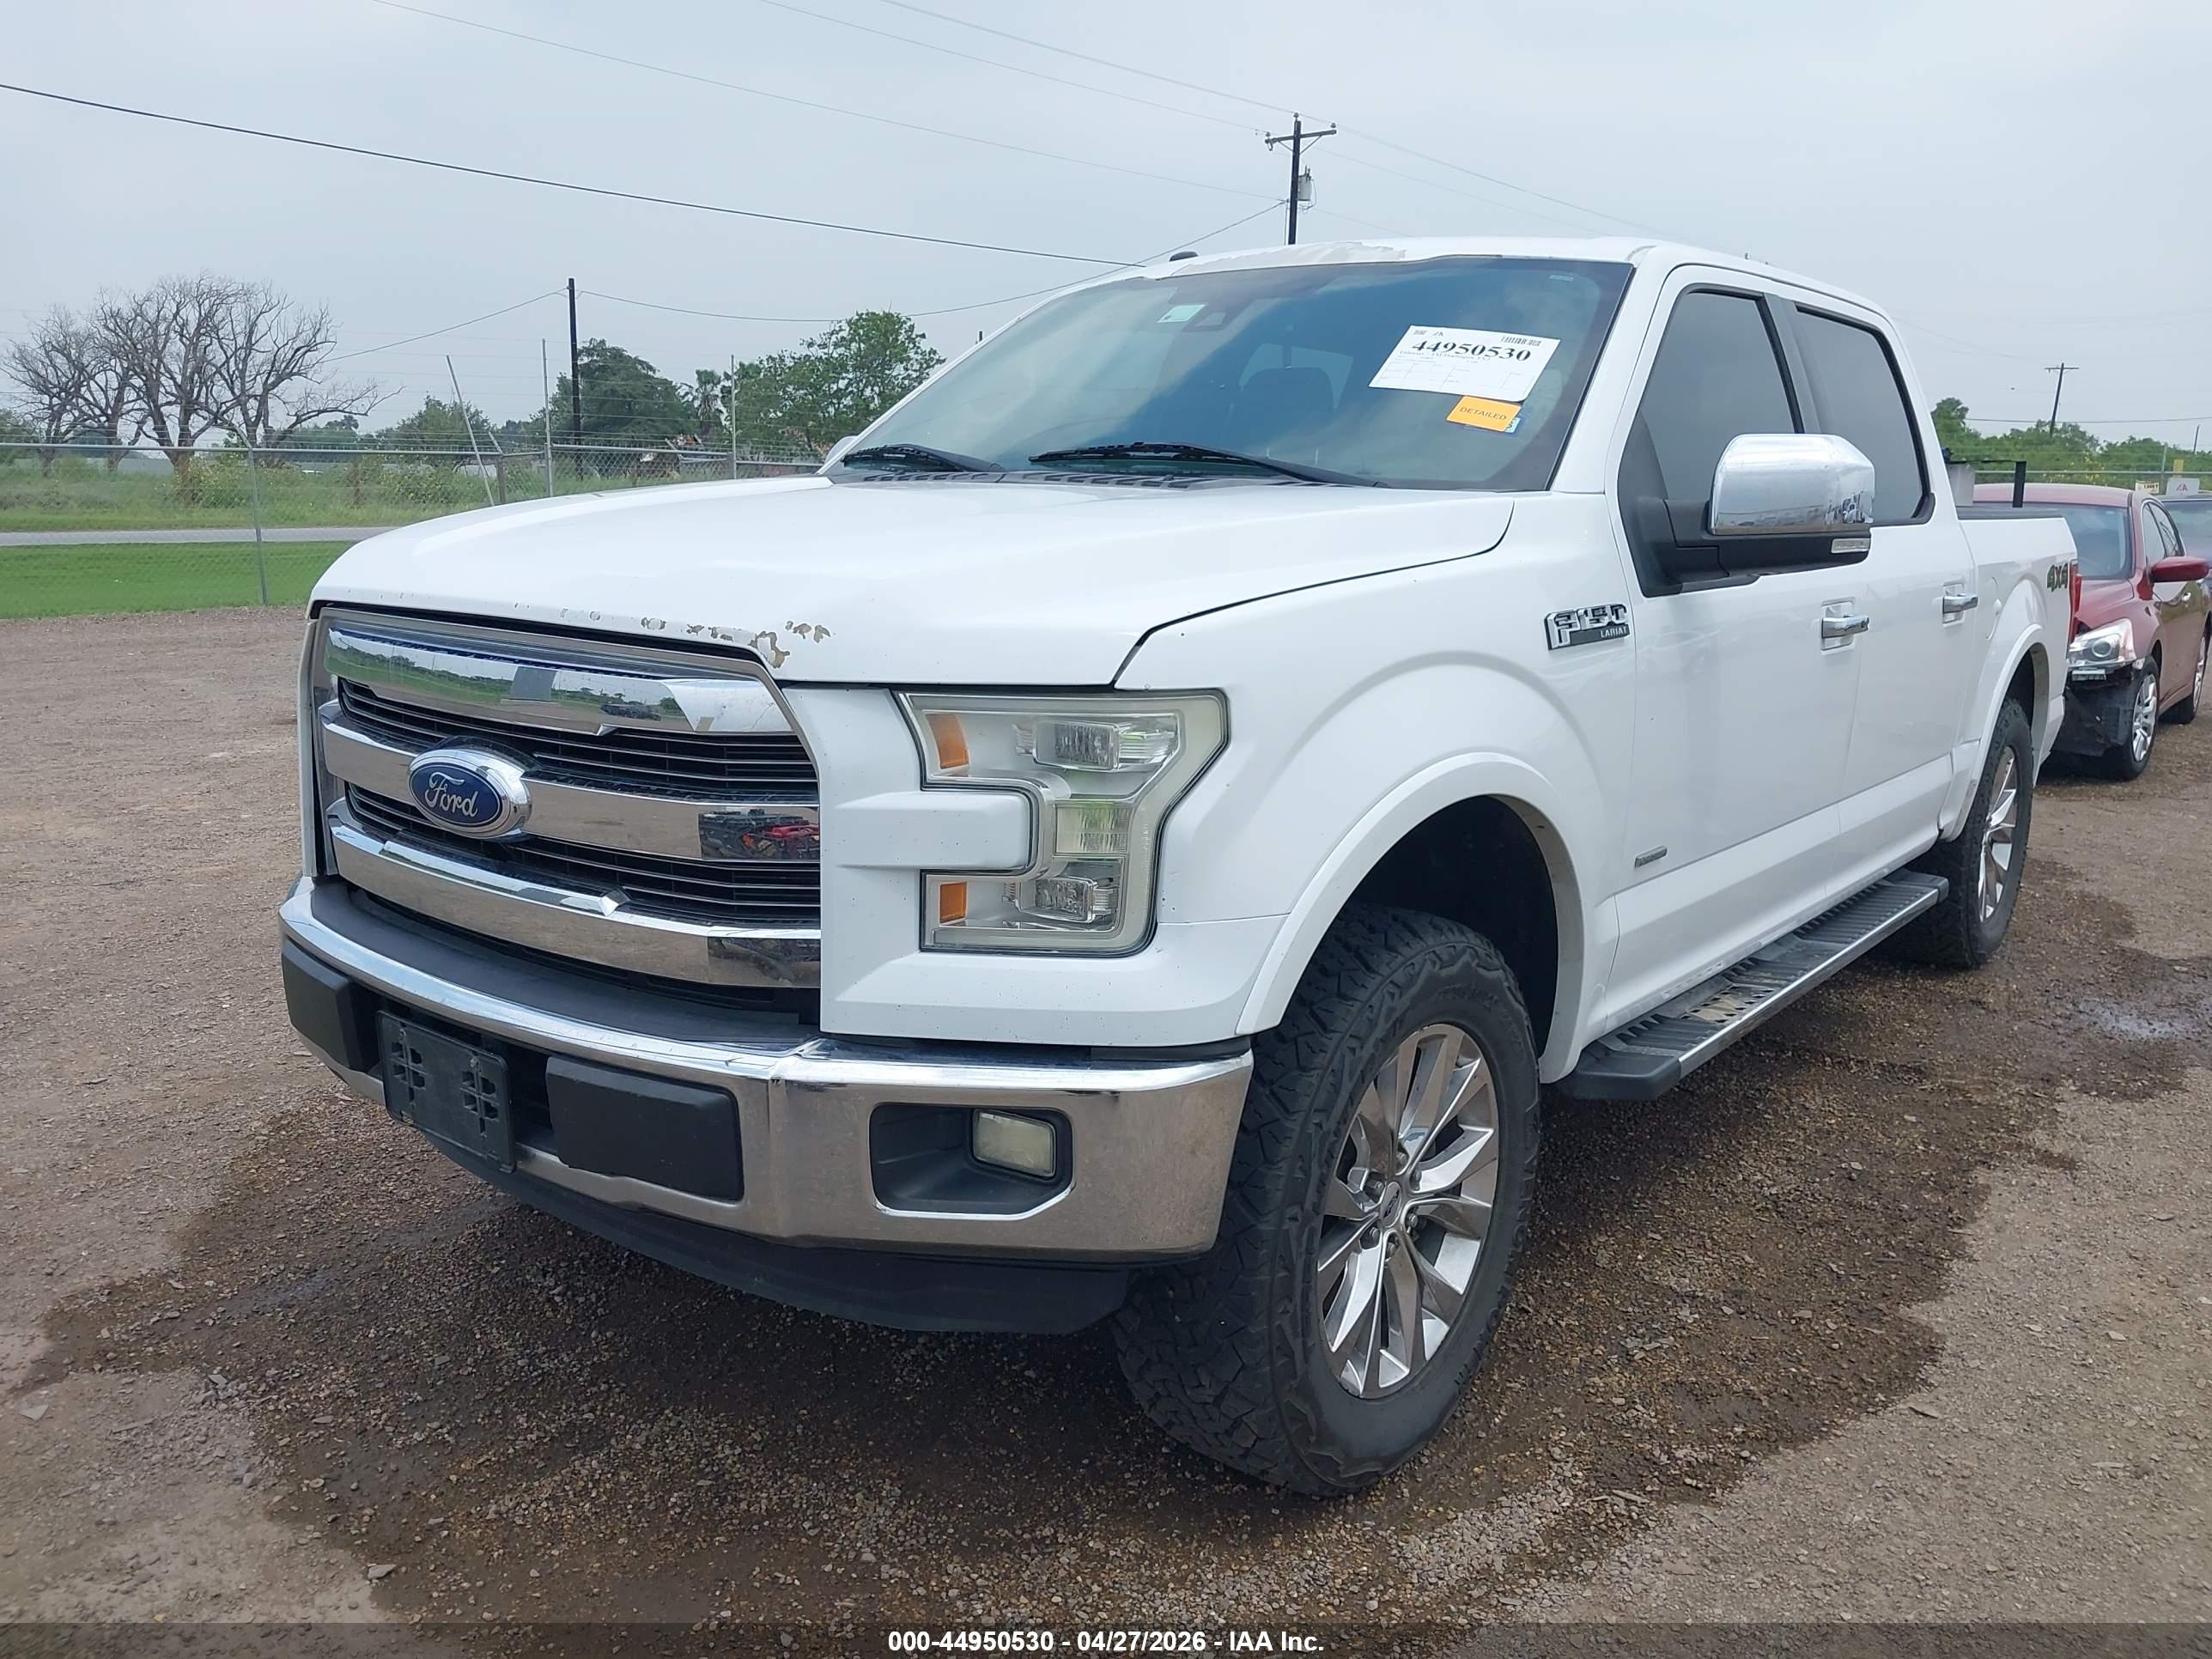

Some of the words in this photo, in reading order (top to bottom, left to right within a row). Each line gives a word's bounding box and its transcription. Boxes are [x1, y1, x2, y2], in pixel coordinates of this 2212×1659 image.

[1412, 340, 1532, 362] 44950530
[1459, 406, 1507, 421] DETAILED
[1600, 625, 1629, 639] LARIAT
[424, 771, 479, 817] Ford
